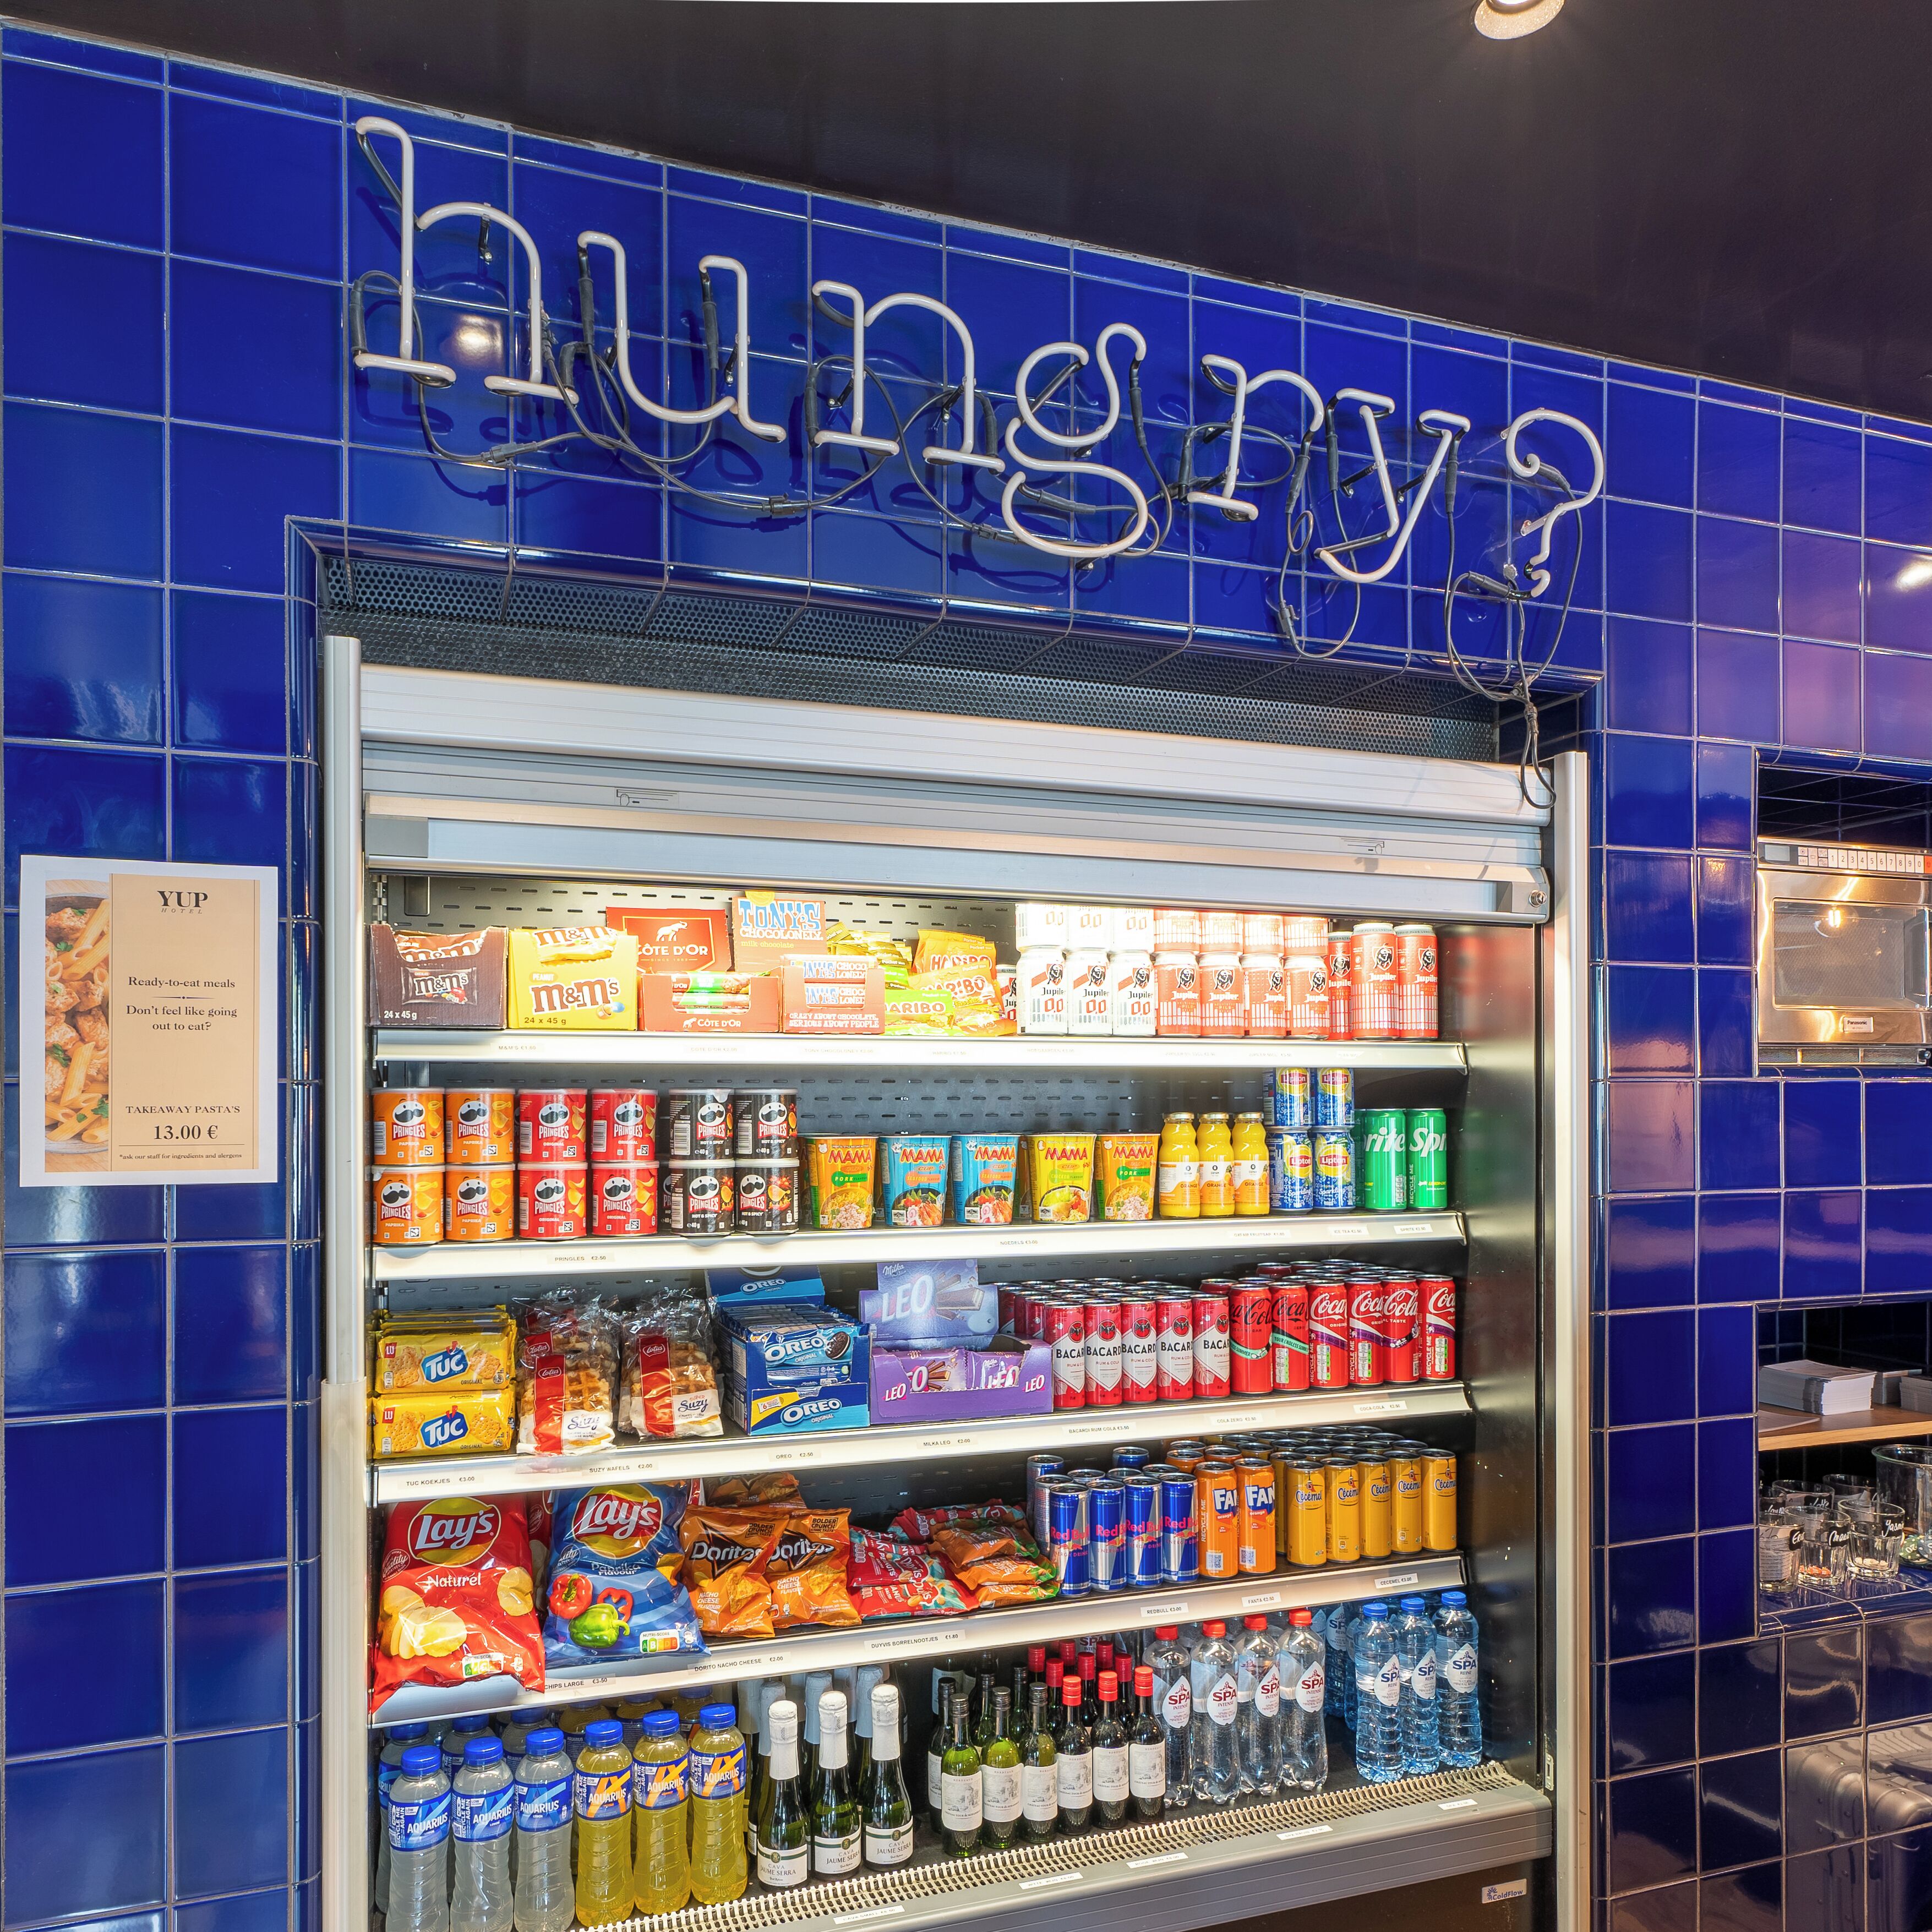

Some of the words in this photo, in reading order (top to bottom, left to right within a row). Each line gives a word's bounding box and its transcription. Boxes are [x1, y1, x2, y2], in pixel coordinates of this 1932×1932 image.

[354, 117, 1606, 600] hungry?
[157, 890, 208, 908] YUP
[738, 899, 822, 930] TONY'S
[128, 976, 200, 988] Ready-to-eat
[204, 978, 235, 988] meals
[1368, 973, 1397, 982] Jupiler
[531, 979, 620, 1013] m&m's
[1083, 989, 1110, 998] Jupiler
[126, 1006, 159, 1016] Don't
[162, 1006, 182, 1016] feel
[185, 1006, 204, 1016] like
[208, 1007, 237, 1018] going
[188, 1022, 211, 1030] eat?
[697, 1018, 718, 1027] CÔTE
[195, 1105, 241, 1114] PASTA'S
[154, 1125, 201, 1139] 13.00
[208, 1125, 218, 1139] €
[392, 1123, 425, 1139] PRINGLES
[458, 1123, 489, 1138] PRINGLES
[538, 1125, 570, 1139] PRINGLES
[614, 1124, 643, 1138] PRINGLES
[827, 1149, 872, 1164] MAMA
[900, 1147, 945, 1163] MAMA
[974, 1147, 1016, 1163] MAMA
[1045, 1147, 1088, 1161] MAMA
[883, 1264, 905, 1275] Milka
[741, 1279, 785, 1293] OREO
[882, 1275, 935, 1322] LEO
[385, 1346, 395, 1355] LU
[647, 1345, 664, 1354] Lotus
[765, 1338, 824, 1362] OREO
[425, 1355, 464, 1380] TUC
[1025, 1374, 1045, 1393] LEO
[885, 1383, 906, 1401] LEO
[678, 1398, 709, 1412] Suzy
[783, 1400, 841, 1423] OREO
[811, 1413, 834, 1423] ORIGINAL
[424, 1418, 464, 1445] TUC
[1296, 1489, 1322, 1503] Cécémel
[578, 1496, 658, 1540] Lay's
[414, 1510, 495, 1550] Lay's
[1096, 1525, 1118, 1536] Red
[691, 1541, 765, 1561] Doritos
[592, 1563, 641, 1573] Paprika
[428, 1572, 482, 1587] Naturel
[892, 1636, 938, 1646] BORRELNOOTJES
[1453, 1660, 1477, 1670] SPA
[1169, 1691, 1190, 1705] SPA
[1213, 1690, 1237, 1702] SPA
[647, 1775, 684, 1793] AQUARIUS
[588, 1787, 627, 1804] AQUARIUS
[520, 1800, 560, 1814] AQUARIUS
[472, 1805, 512, 1824] AQUARIUS
[897, 1842, 912, 1852] SERRA
[1493, 1889, 1523, 1901] ColdFlow
